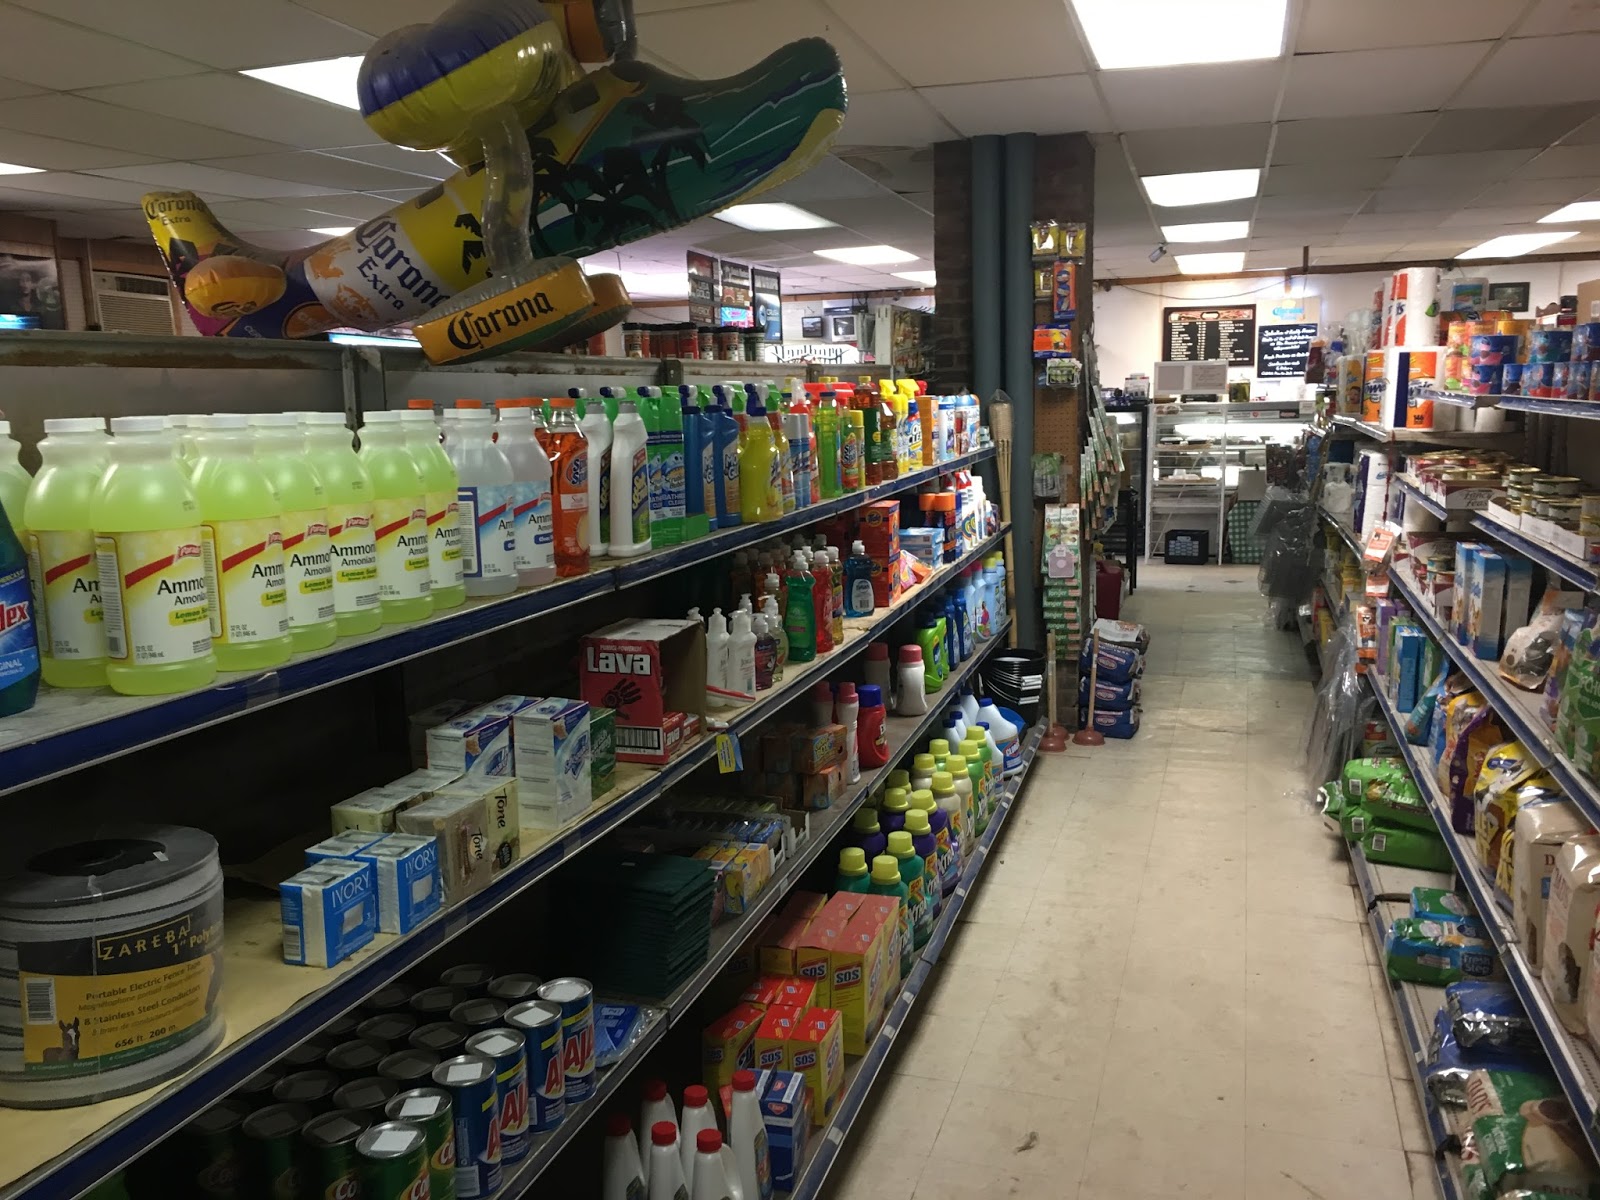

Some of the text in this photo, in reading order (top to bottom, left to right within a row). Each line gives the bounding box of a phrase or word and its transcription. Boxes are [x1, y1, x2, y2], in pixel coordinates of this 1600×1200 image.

[162, 216, 191, 225] Extra
[357, 256, 404, 310] Extra
[447, 292, 555, 350] Corona
[586, 646, 651, 676] Lava
[494, 788, 508, 829] Tone
[470, 826, 483, 861] Tone
[406, 846, 437, 878] IVORY
[332, 871, 371, 908] IVORY
[102, 926, 188, 961] ZAREBA
[86, 986, 127, 1000] Portable
[130, 978, 162, 990] Electric
[163, 969, 185, 982] Fence
[802, 965, 825, 977] SOS
[836, 970, 860, 983] SOS
[138, 1000, 159, 1014] Steel
[161, 984, 201, 1006] Conductors
[114, 1038, 134, 1049] 656
[149, 1027, 167, 1039] 200
[760, 1048, 782, 1064] SOS
[795, 1051, 815, 1066] SOS
